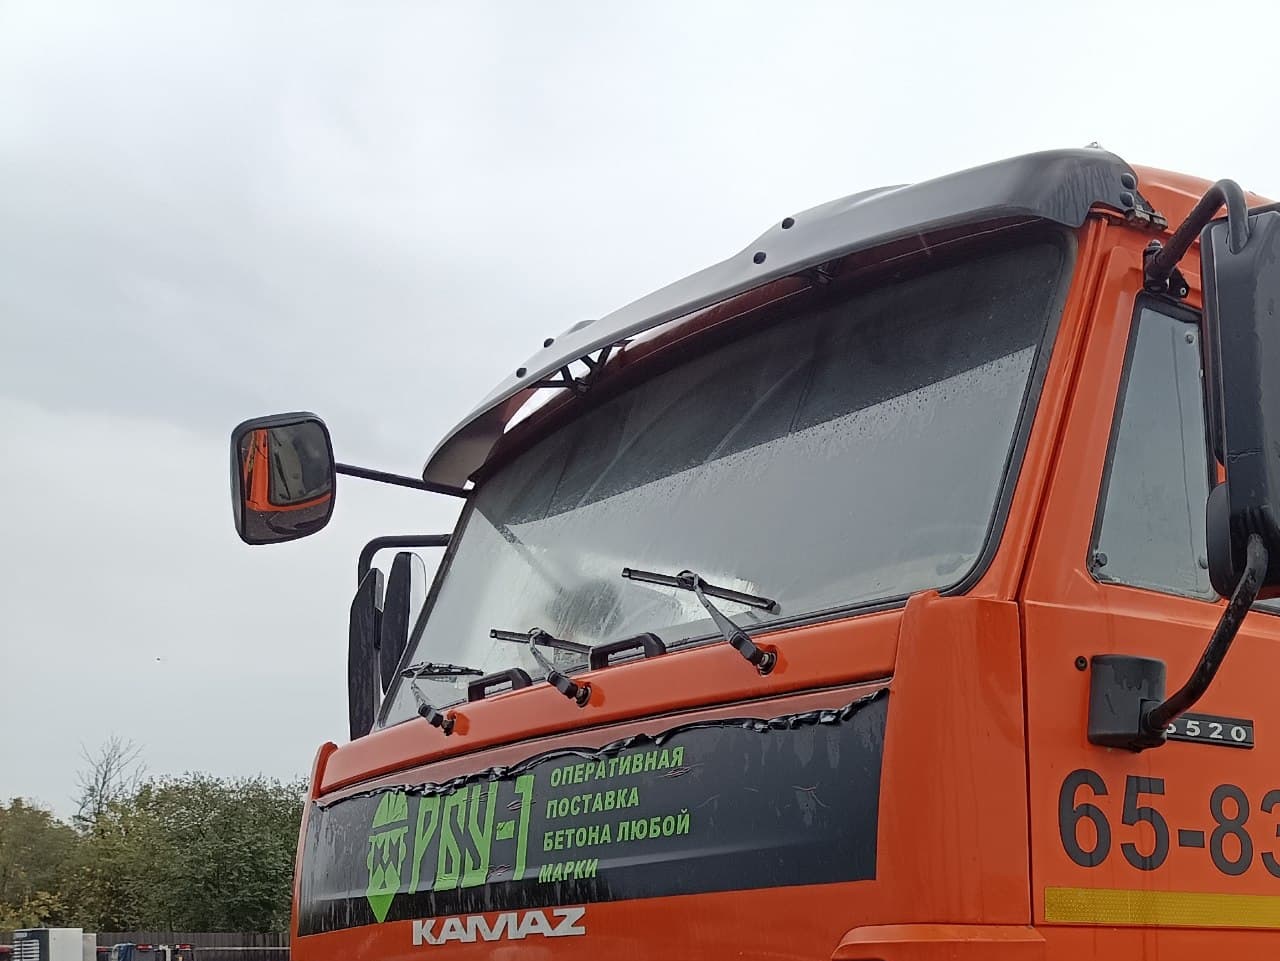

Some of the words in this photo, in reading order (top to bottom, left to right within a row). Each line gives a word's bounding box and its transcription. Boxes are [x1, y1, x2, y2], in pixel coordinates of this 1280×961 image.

[550, 746, 685, 788] ОПЕРАТИВНАЯ
[545, 786, 640, 820] ПОСТАВКА
[543, 823, 612, 852] БЕТОНА
[616, 808, 691, 843] ЛЮБОЙ
[538, 858, 599, 884] МАРКИ
[412, 906, 586, 946] KAMAZ
